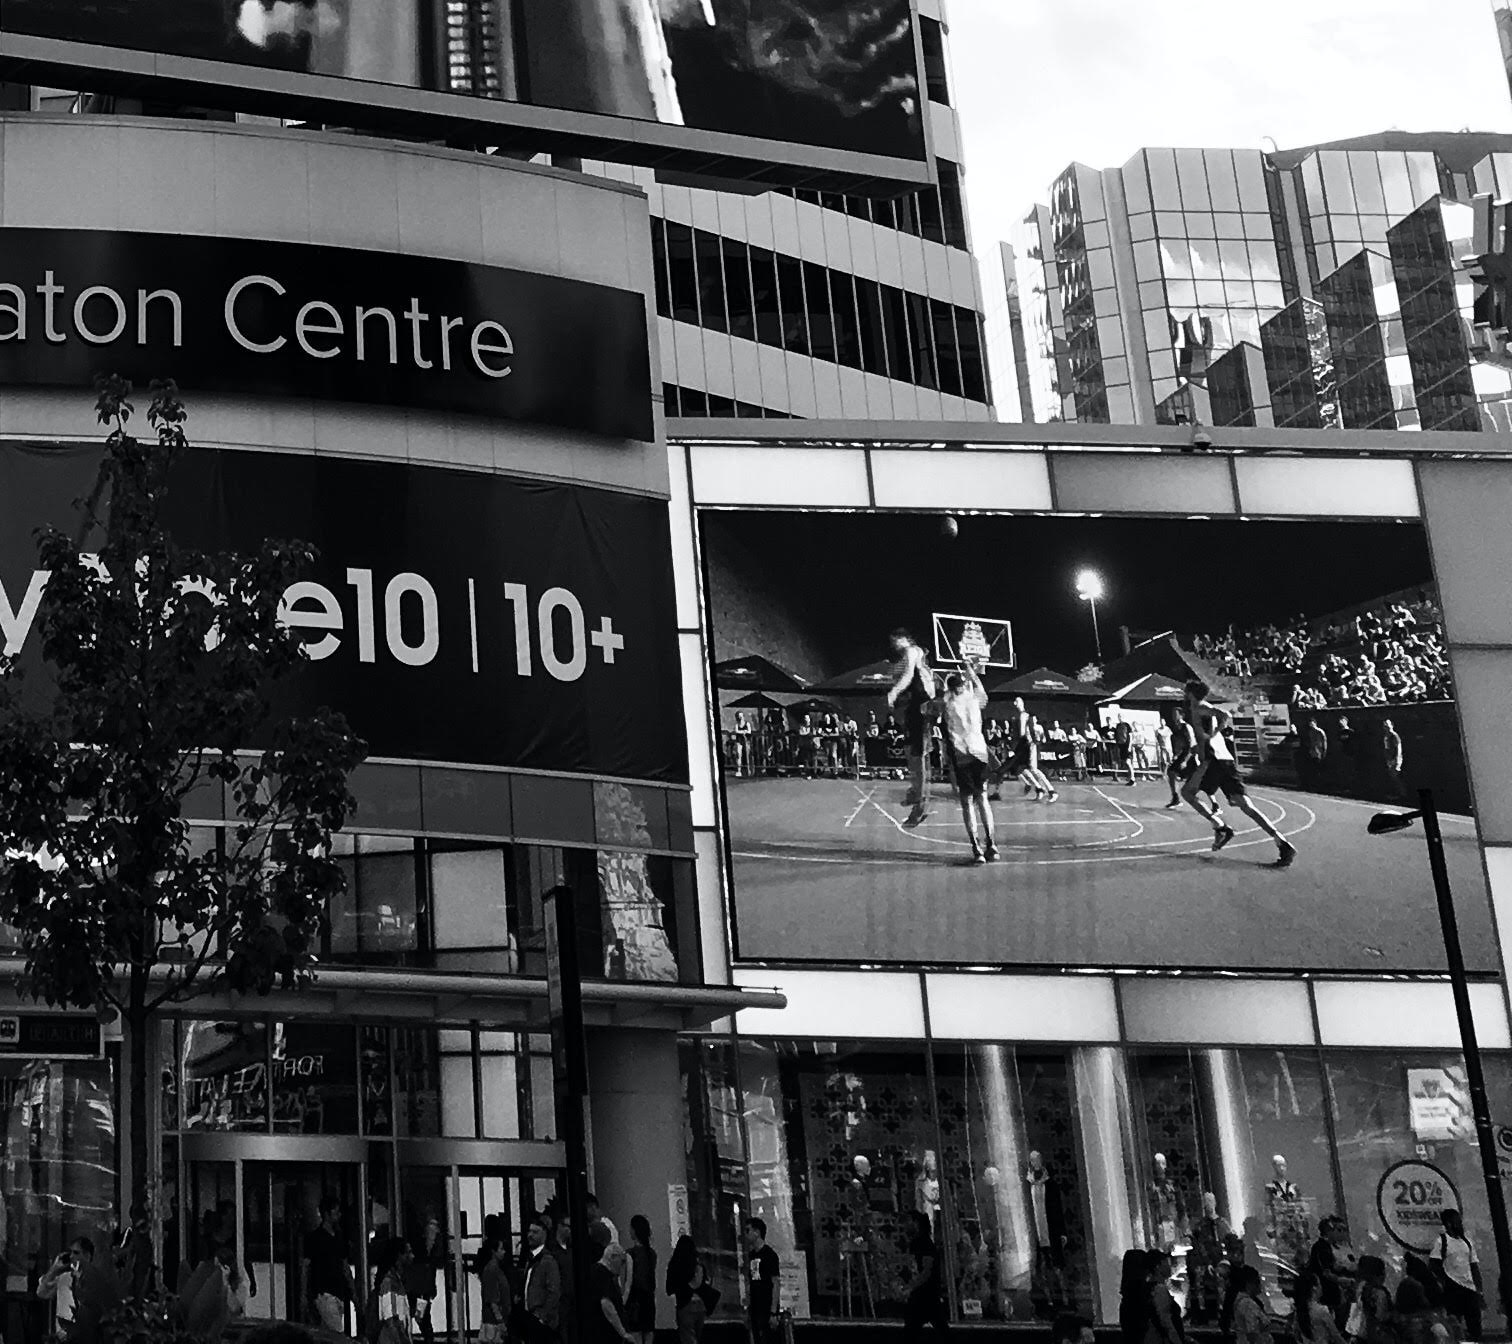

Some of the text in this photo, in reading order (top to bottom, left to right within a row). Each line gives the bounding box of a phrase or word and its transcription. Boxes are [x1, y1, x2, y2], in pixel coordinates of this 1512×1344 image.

[224, 275, 514, 378] Centre
[504, 582, 625, 682] 10+
[1393, 1180, 1443, 1206] 20%
